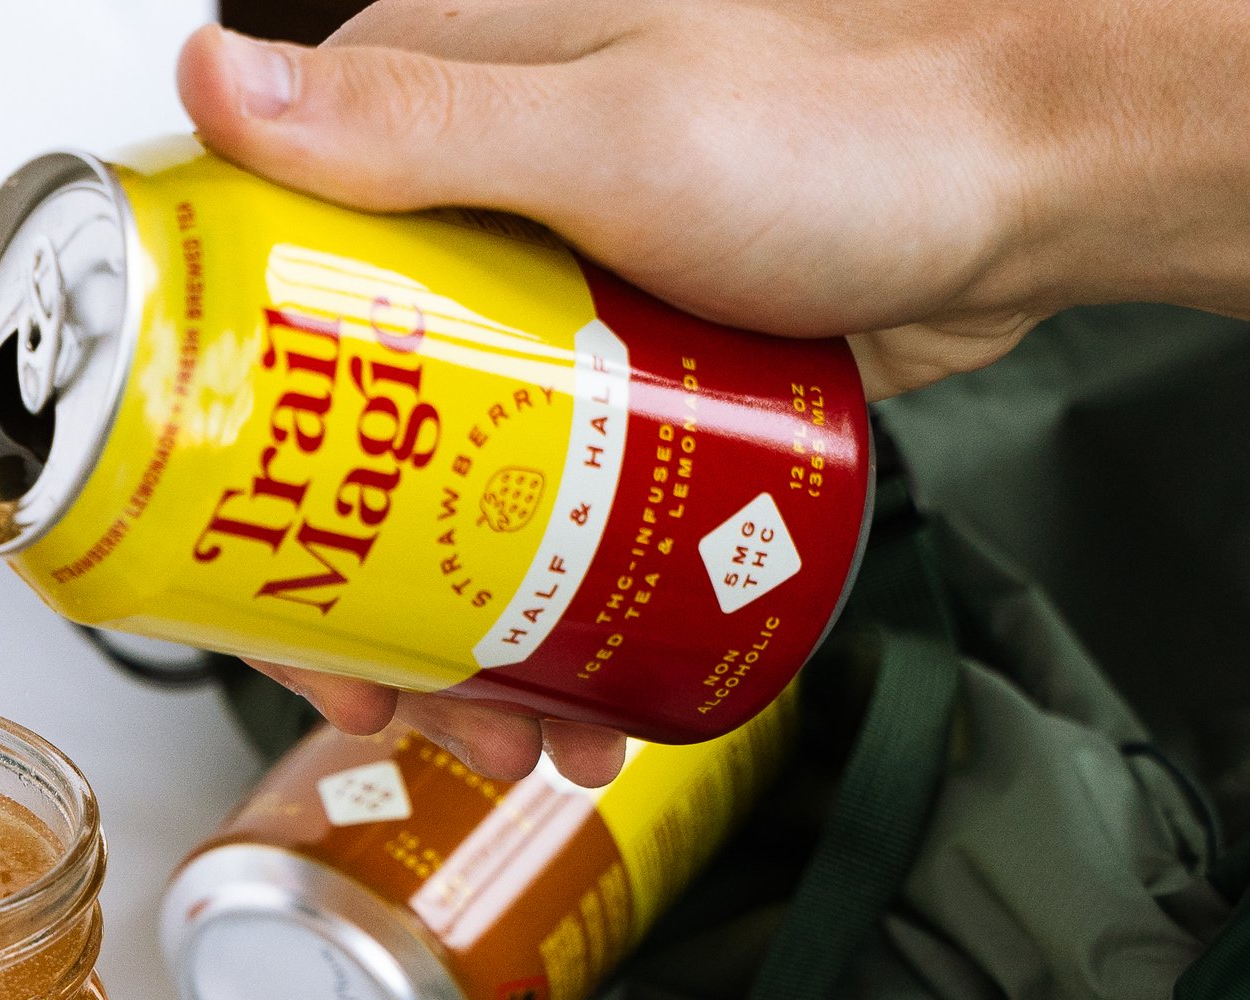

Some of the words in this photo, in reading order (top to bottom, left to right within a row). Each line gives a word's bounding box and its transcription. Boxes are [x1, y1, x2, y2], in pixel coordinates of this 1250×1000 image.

[130, 423, 178, 519] LEMONADE
[182, 238, 204, 321] BREWED
[792, 383, 805, 411] OZ
[812, 386, 825, 427] ML)
[192, 307, 342, 563] Trail
[254, 296, 441, 617] Magic
[790, 424, 807, 457] FL
[808, 439, 825, 498] (355
[437, 386, 555, 608] STRAWBERRY
[502, 555, 567, 646] HALF
[569, 503, 592, 527] &
[584, 353, 611, 468] HALF
[627, 572, 660, 620] TEA
[658, 537, 674, 555] &
[669, 356, 697, 518] LEMONADE
[789, 466, 806, 490] 12
[596, 423, 674, 623] THC-INFUSED
[723, 521, 756, 588] 5MG
[743, 526, 775, 590] THC
[578, 634, 623, 680] ICED
[697, 615, 781, 715] ALCOHOLIC
[703, 648, 741, 687] NON
